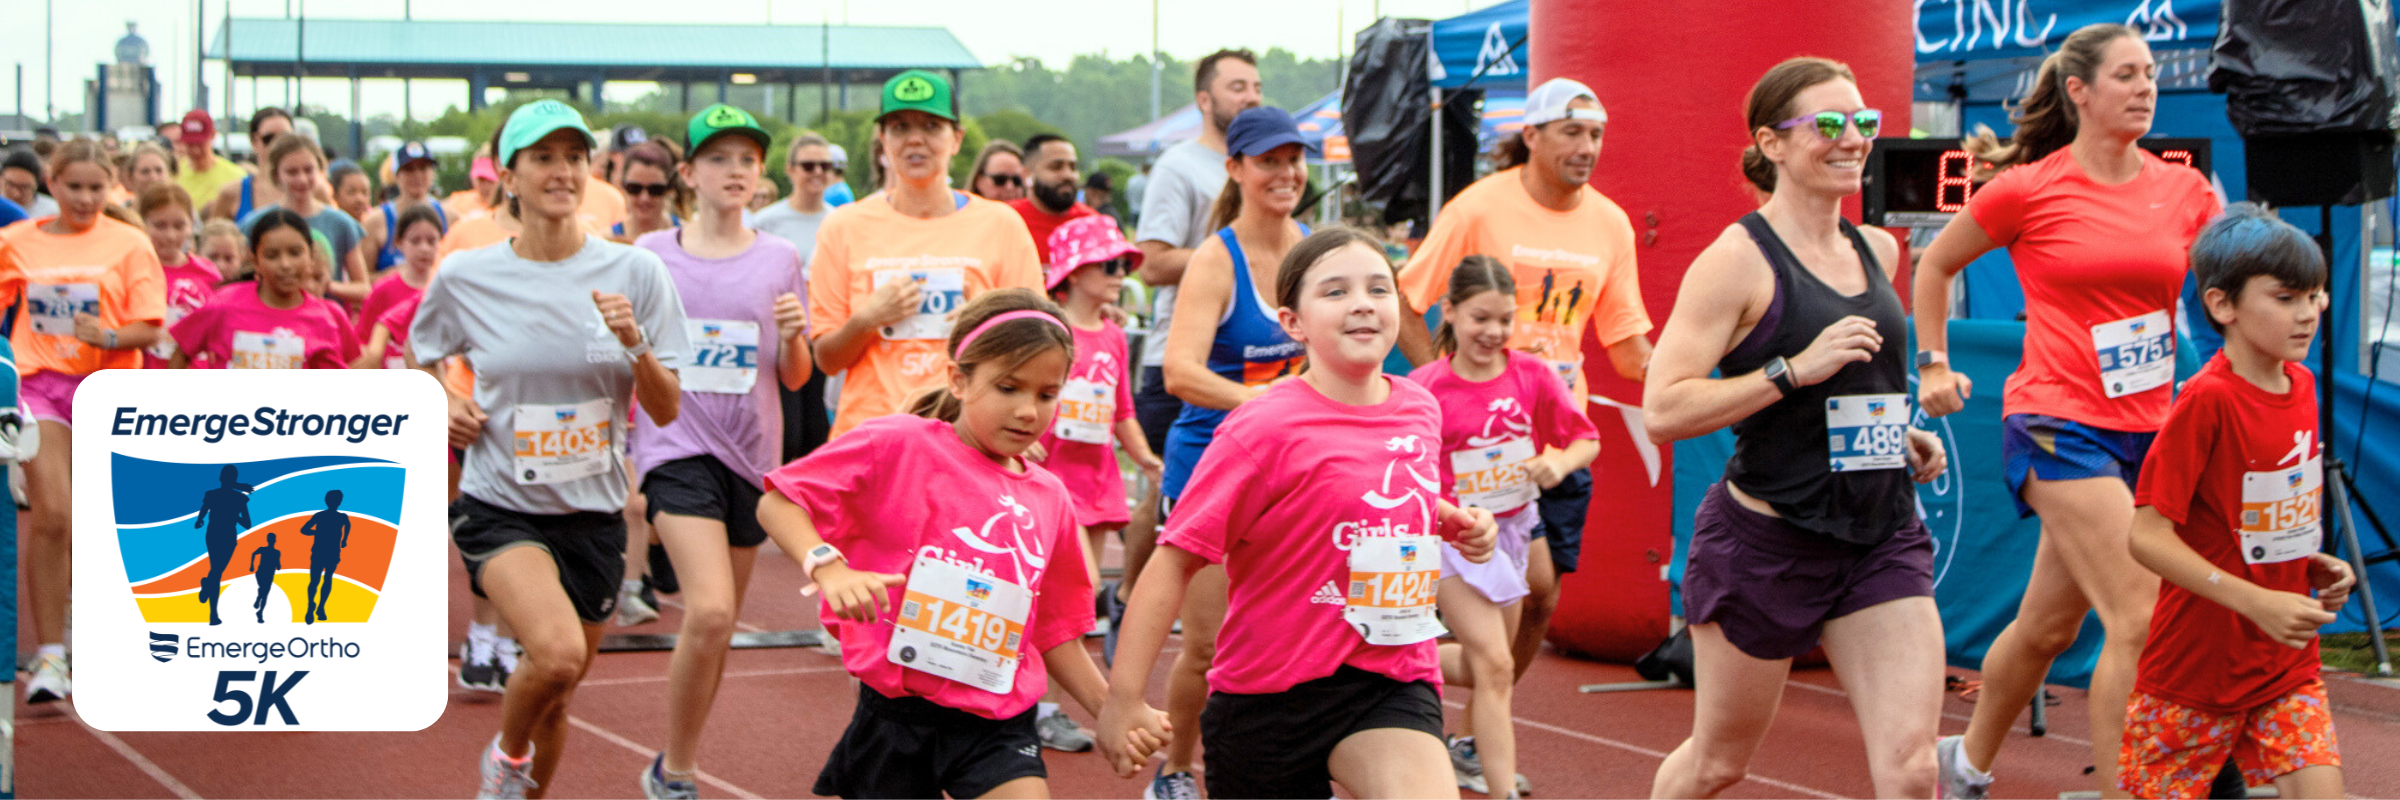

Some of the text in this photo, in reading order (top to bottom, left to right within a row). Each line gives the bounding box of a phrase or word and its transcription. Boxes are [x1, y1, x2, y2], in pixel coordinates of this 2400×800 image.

[902, 352, 939, 376] 5K
[2119, 336, 2164, 368] 575
[529, 426, 599, 457] 1403
[1852, 424, 1902, 455] 489
[1467, 462, 1528, 494] 1429
[2263, 490, 2319, 531] 1521
[1367, 572, 1431, 606] 1424
[926, 600, 1006, 651] 1419
